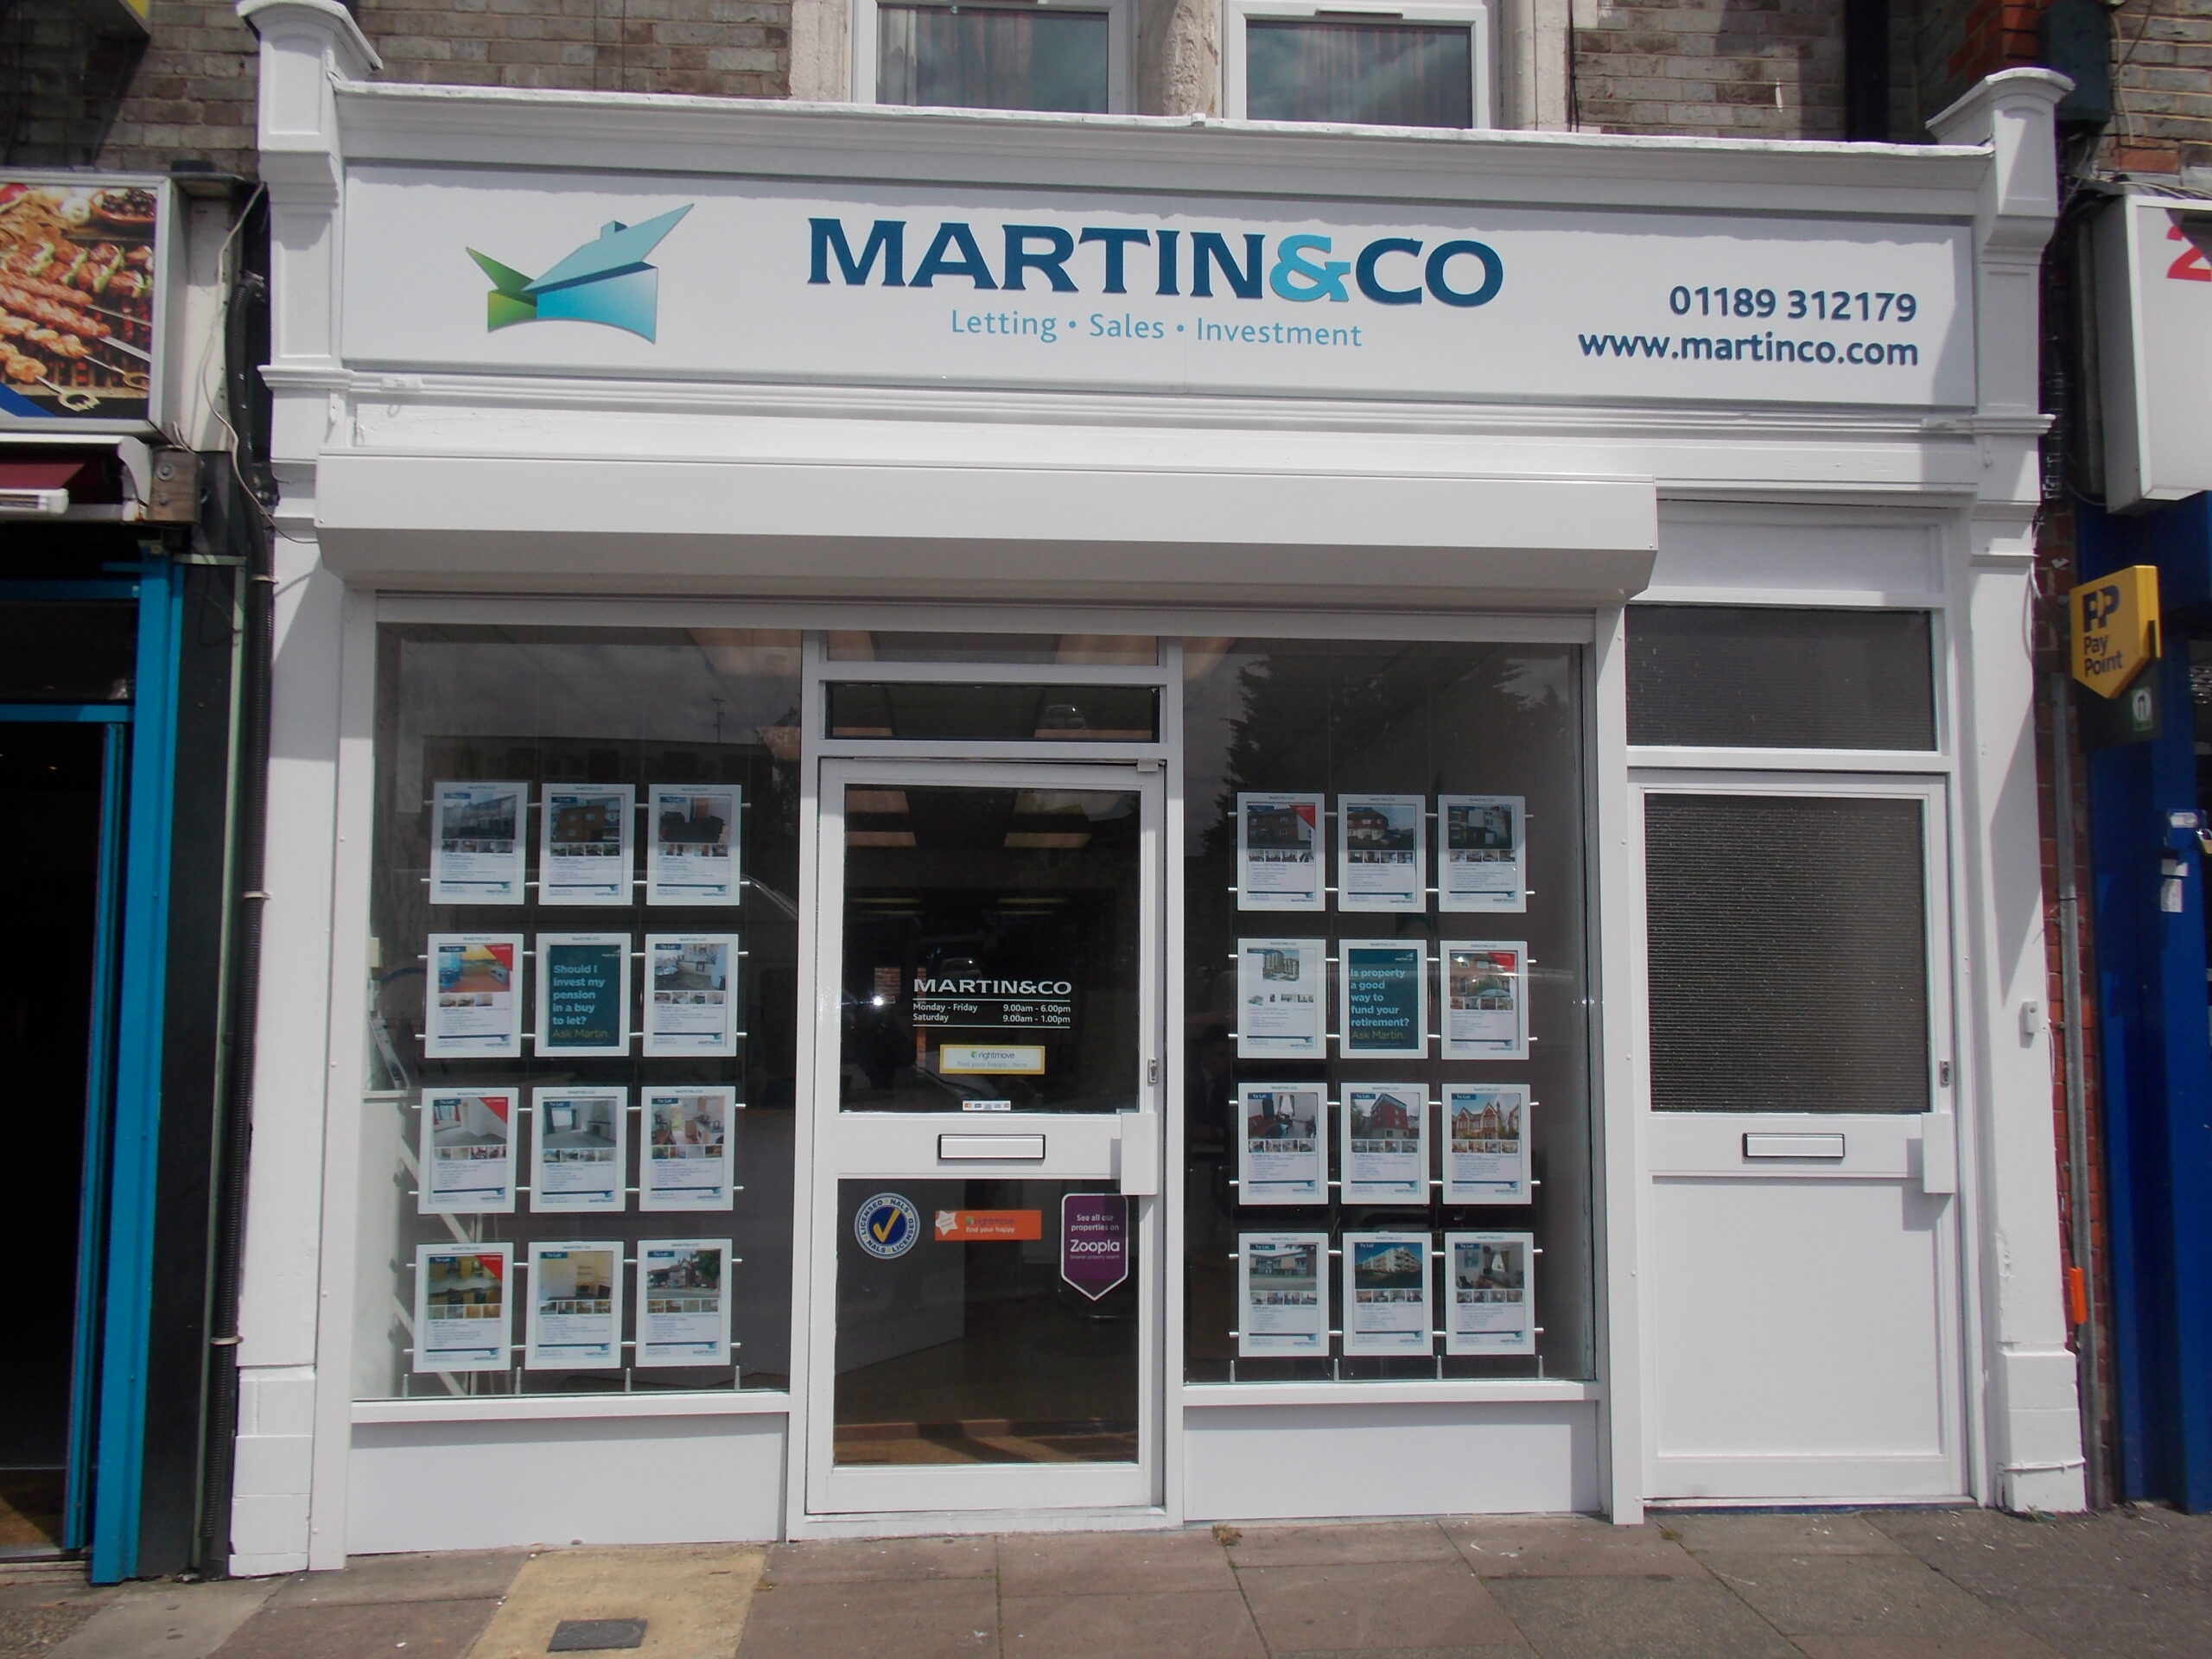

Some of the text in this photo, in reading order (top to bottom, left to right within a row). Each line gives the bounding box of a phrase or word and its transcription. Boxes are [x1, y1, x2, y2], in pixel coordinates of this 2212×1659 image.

[808, 217, 1504, 308] MARTIN&CO
[1669, 286, 1916, 322] 01189 312179
[951, 309, 1363, 347] Letting Sales Investment
[1579, 331, 1919, 367] www.martinco.com
[2084, 636, 2109, 656] Pay
[2084, 651, 2123, 677] Point
[553, 964, 598, 975] Should I
[1351, 969, 1405, 980] Is property
[553, 976, 606, 989] invest my
[912, 978, 1072, 995] MARTIN&CO
[1351, 980, 1385, 992] a good
[553, 989, 595, 1002] pension
[1351, 993, 1384, 1004] way to
[553, 1002, 563, 1013] in
[574, 1002, 595, 1014] buy
[912, 1003, 946, 1013] Monday
[953, 1003, 978, 1014] Friday
[1003, 1004, 1033, 1013] 9.00am
[1040, 1004, 1071, 1014] 6.00pm
[1351, 1005, 1399, 1017] fund your
[553, 1015, 587, 1026] to let?
[912, 1013, 950, 1022] Saturday
[1002, 1014, 1033, 1023] 9.00am
[1041, 1015, 1071, 1025] 1.00pm
[1351, 1017, 1409, 1027] retirement?
[552, 1028, 610, 1039] Ask Martin.
[1351, 1029, 1405, 1039] Ask Martin.
[978, 1052, 1015, 1060] rightmove
[890, 1198, 910, 1213] NALS
[860, 1199, 883, 1236] LICENSED
[1071, 1224, 1109, 1232] properties
[892, 1217, 915, 1253] LICENSED
[867, 1239, 887, 1253] NALS
[1071, 1239, 1120, 1255] Zoopla
